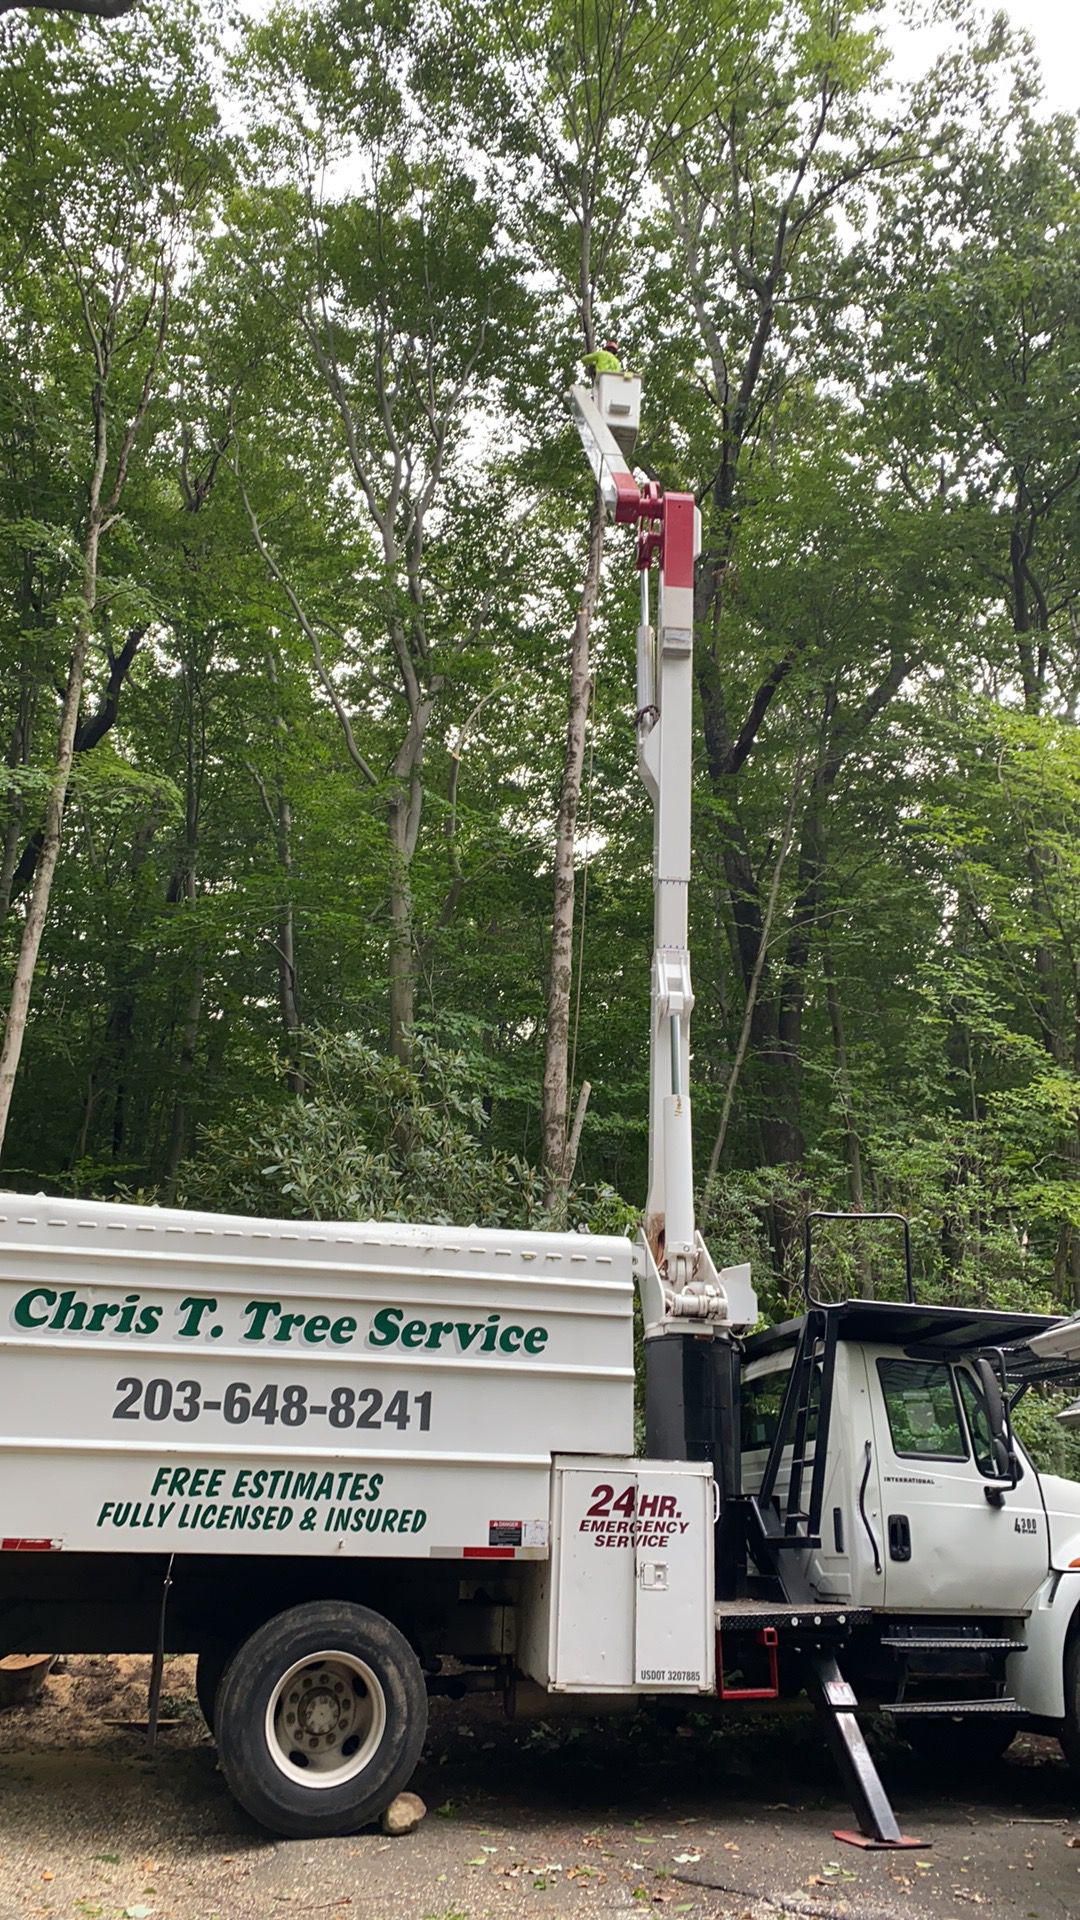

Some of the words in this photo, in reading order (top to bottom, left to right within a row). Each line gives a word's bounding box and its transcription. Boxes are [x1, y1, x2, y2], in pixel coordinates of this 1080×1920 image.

[14, 1288, 163, 1334] Chris
[177, 1297, 223, 1338] T.
[243, 1301, 357, 1344] Tree
[368, 1308, 549, 1354] Service
[112, 1377, 433, 1432] 203-648-8241
[150, 1467, 226, 1497] FREE
[231, 1470, 384, 1501] ESTIMATES
[883, 1476, 935, 1485] INTERNATIONAL
[586, 1484, 639, 1518] 24
[638, 1494, 683, 1518] HR.
[96, 1502, 176, 1528] FULLY
[177, 1504, 293, 1531] LICENSED
[299, 1507, 316, 1532] &
[324, 1507, 427, 1534] INSURED
[579, 1520, 690, 1534] EMERGENCY
[594, 1535, 670, 1548] SERVICE
[640, 1670, 666, 1681] USDOT
[667, 1671, 701, 1682] 3207885
